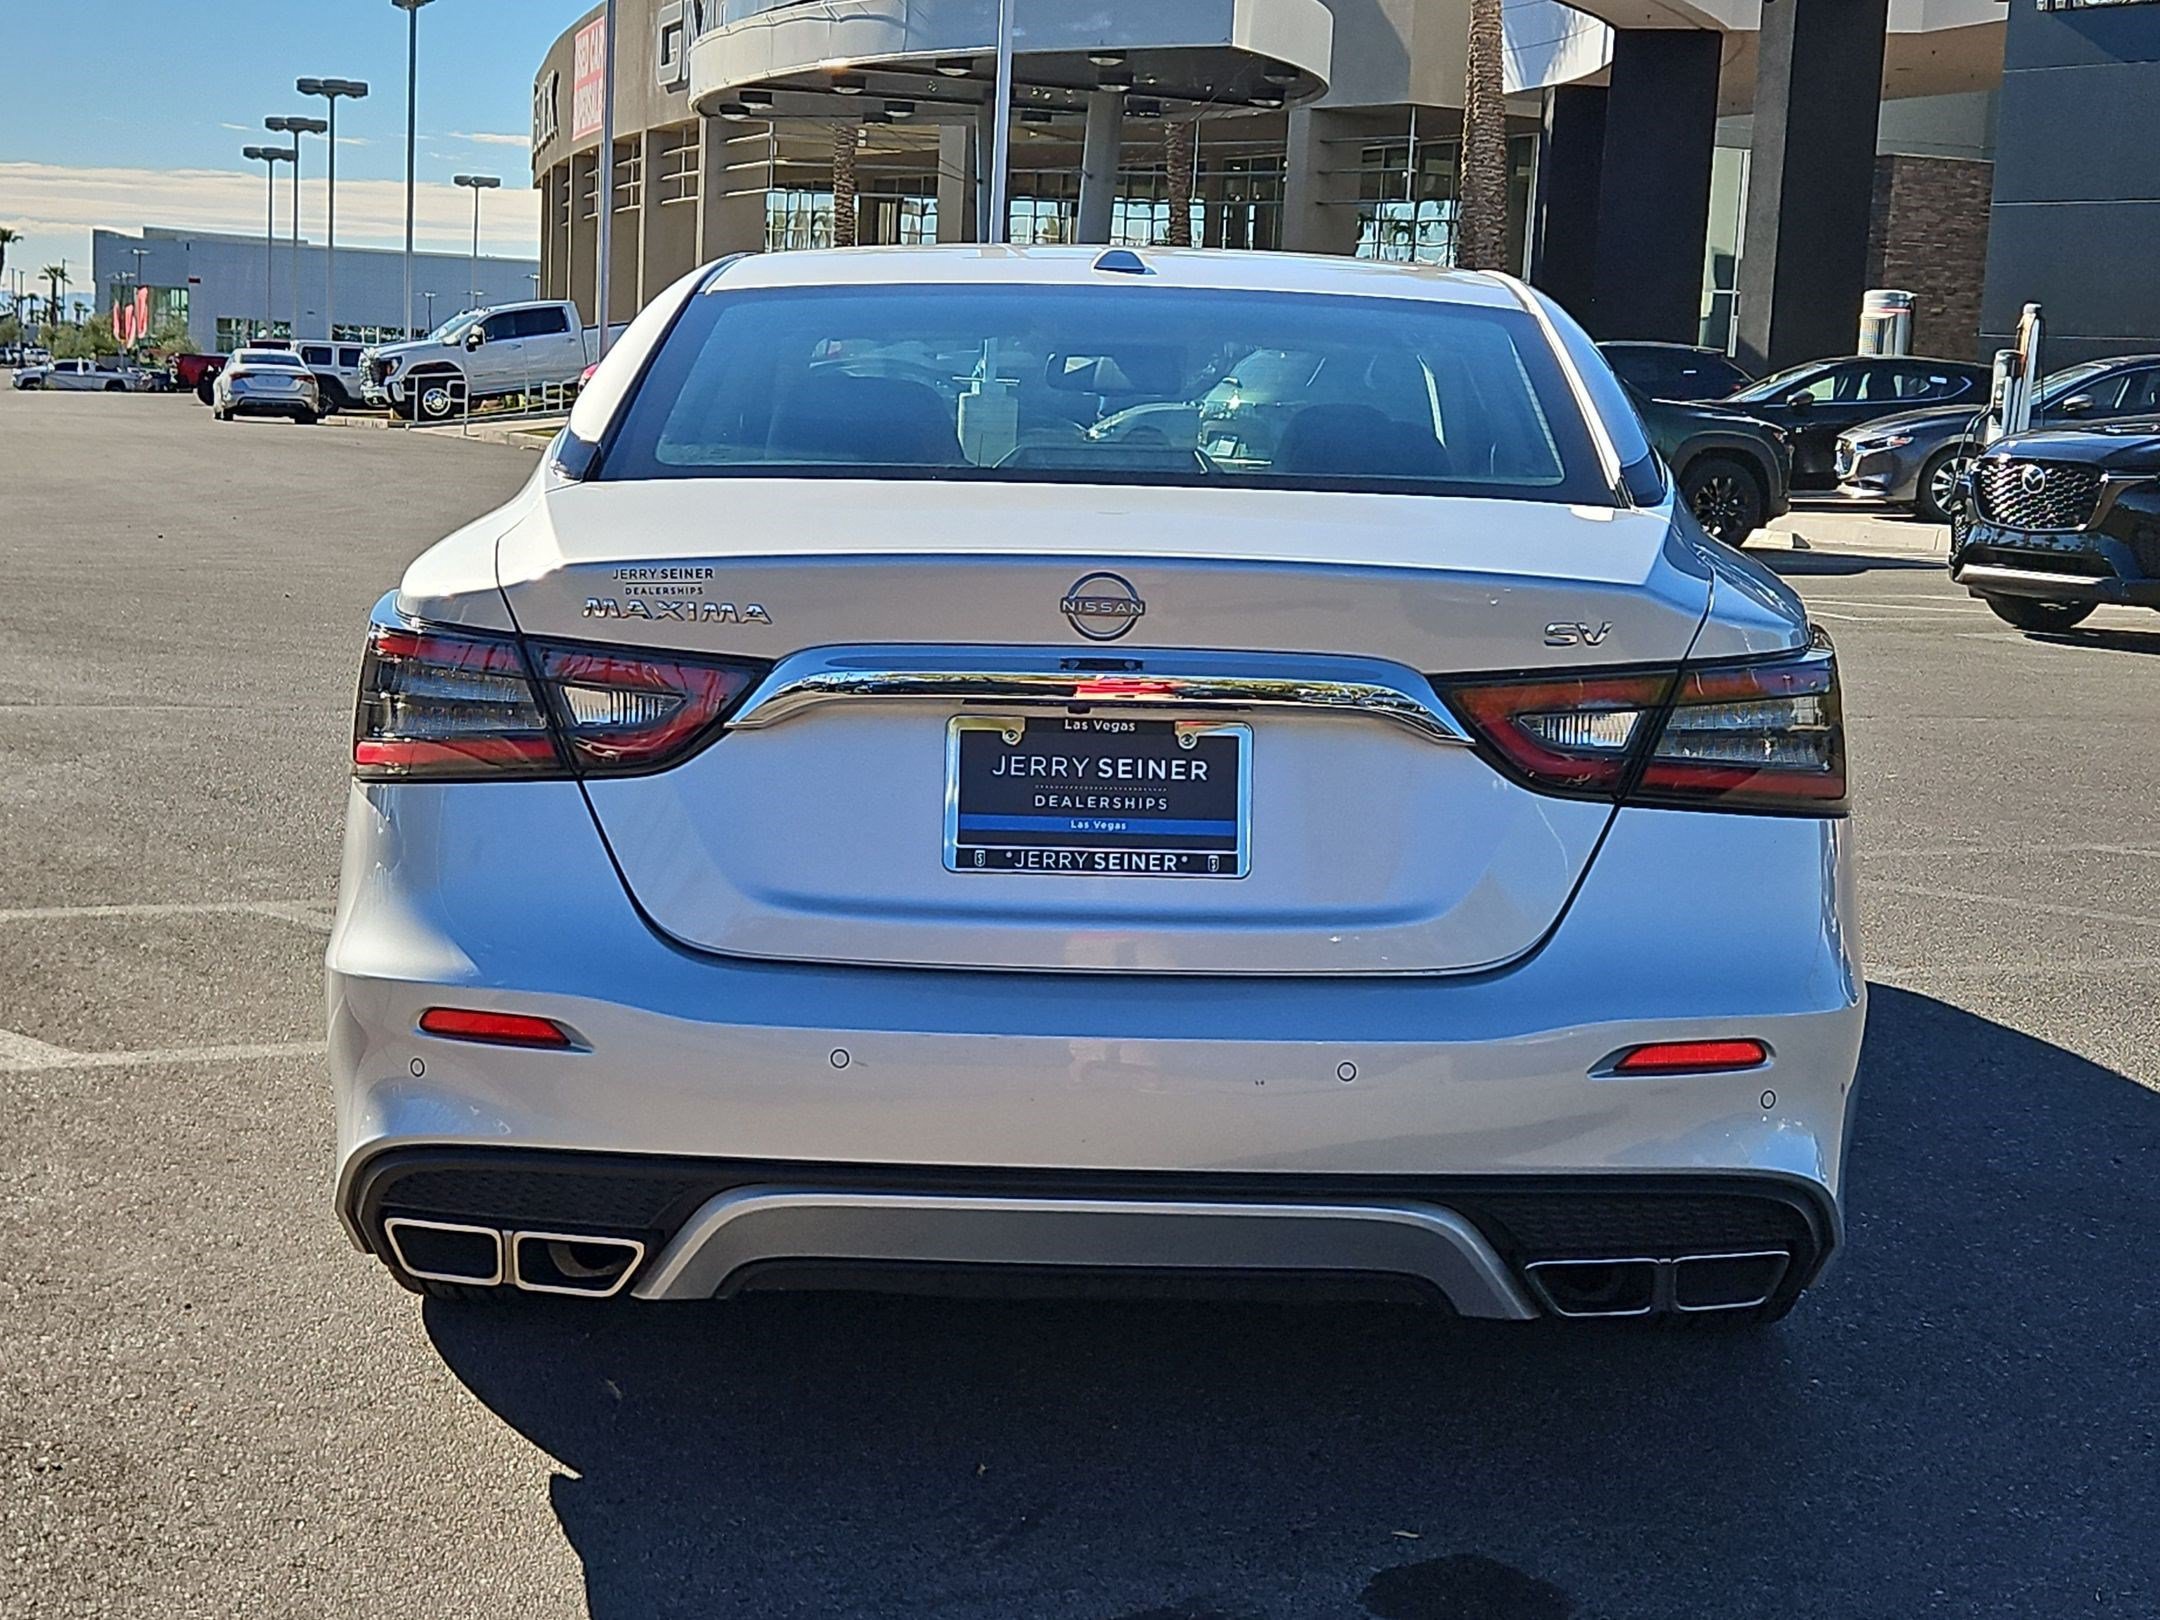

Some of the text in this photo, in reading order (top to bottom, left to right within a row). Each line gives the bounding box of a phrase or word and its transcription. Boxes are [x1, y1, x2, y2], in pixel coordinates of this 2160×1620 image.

[613, 568, 714, 579] JERRY SEINER
[625, 586, 703, 596] DEALERSHIPS
[582, 598, 773, 624] MAXIMA
[1062, 600, 1143, 613] NISSAN
[1543, 621, 1613, 647] SV
[1064, 718, 1136, 733] Las Vegas
[992, 756, 1208, 781] JERRY SEINER
[1034, 795, 1168, 810] DEALERSHIPS
[1070, 820, 1127, 831] Las Vegas
[1014, 851, 1178, 871] JERRY SEINER
